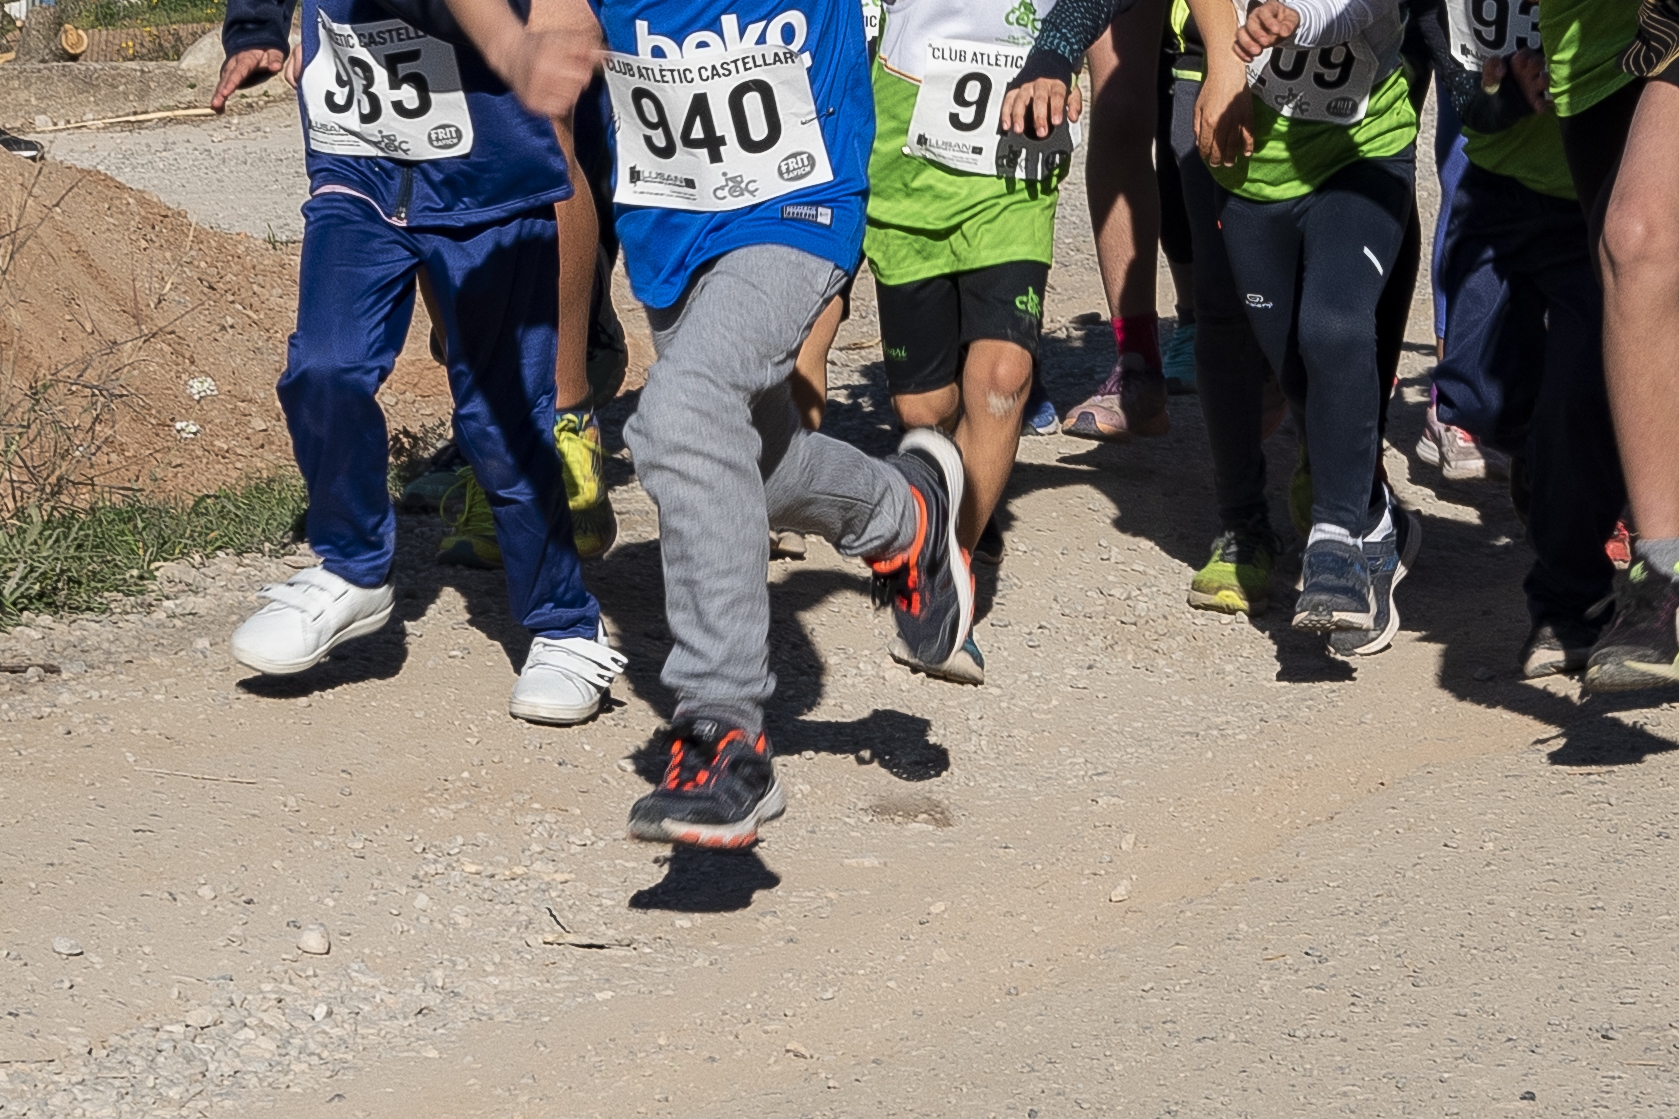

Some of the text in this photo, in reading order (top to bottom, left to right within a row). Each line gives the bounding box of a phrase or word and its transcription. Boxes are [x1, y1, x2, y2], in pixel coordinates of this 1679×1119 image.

[359, 26, 428, 49] CASTELL
[606, 51, 797, 84] CLUB ATLÈTIC CASTELLAR
[931, 47, 1024, 69] CLUB ATLÈTIC
[324, 48, 433, 125] 935
[631, 79, 782, 164] 940
[430, 128, 458, 140] FRIT
[780, 153, 809, 173] FRIT
